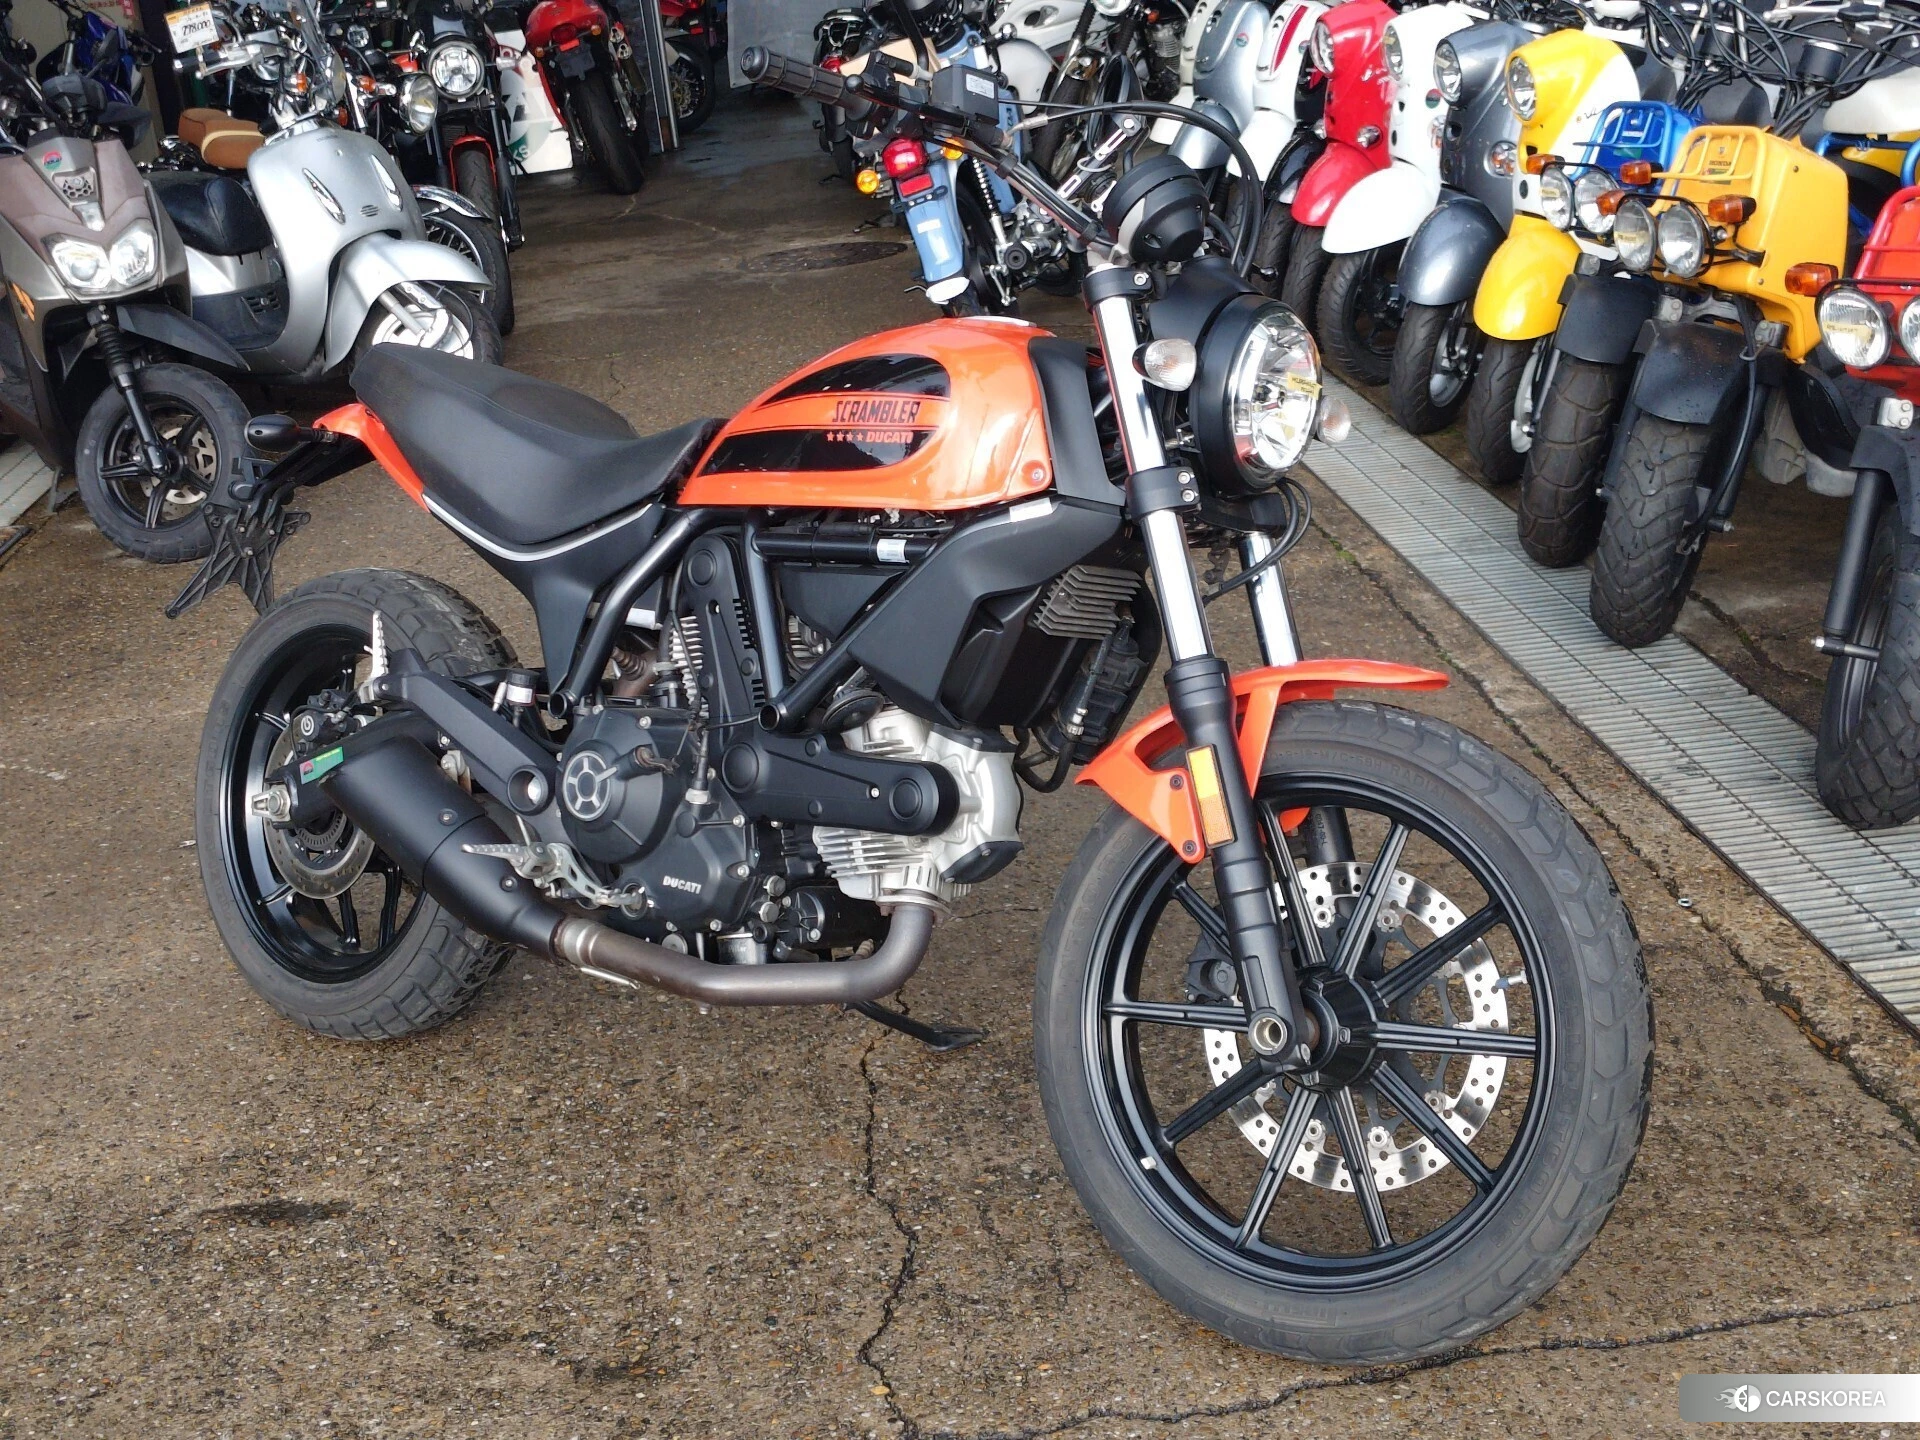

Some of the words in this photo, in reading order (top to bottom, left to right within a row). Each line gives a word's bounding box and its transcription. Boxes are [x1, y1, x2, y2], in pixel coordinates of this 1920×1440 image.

[832, 400, 921, 423] SCRAMBLER
[866, 431, 914, 444] DUCATI
[662, 875, 702, 895] DUCATI
